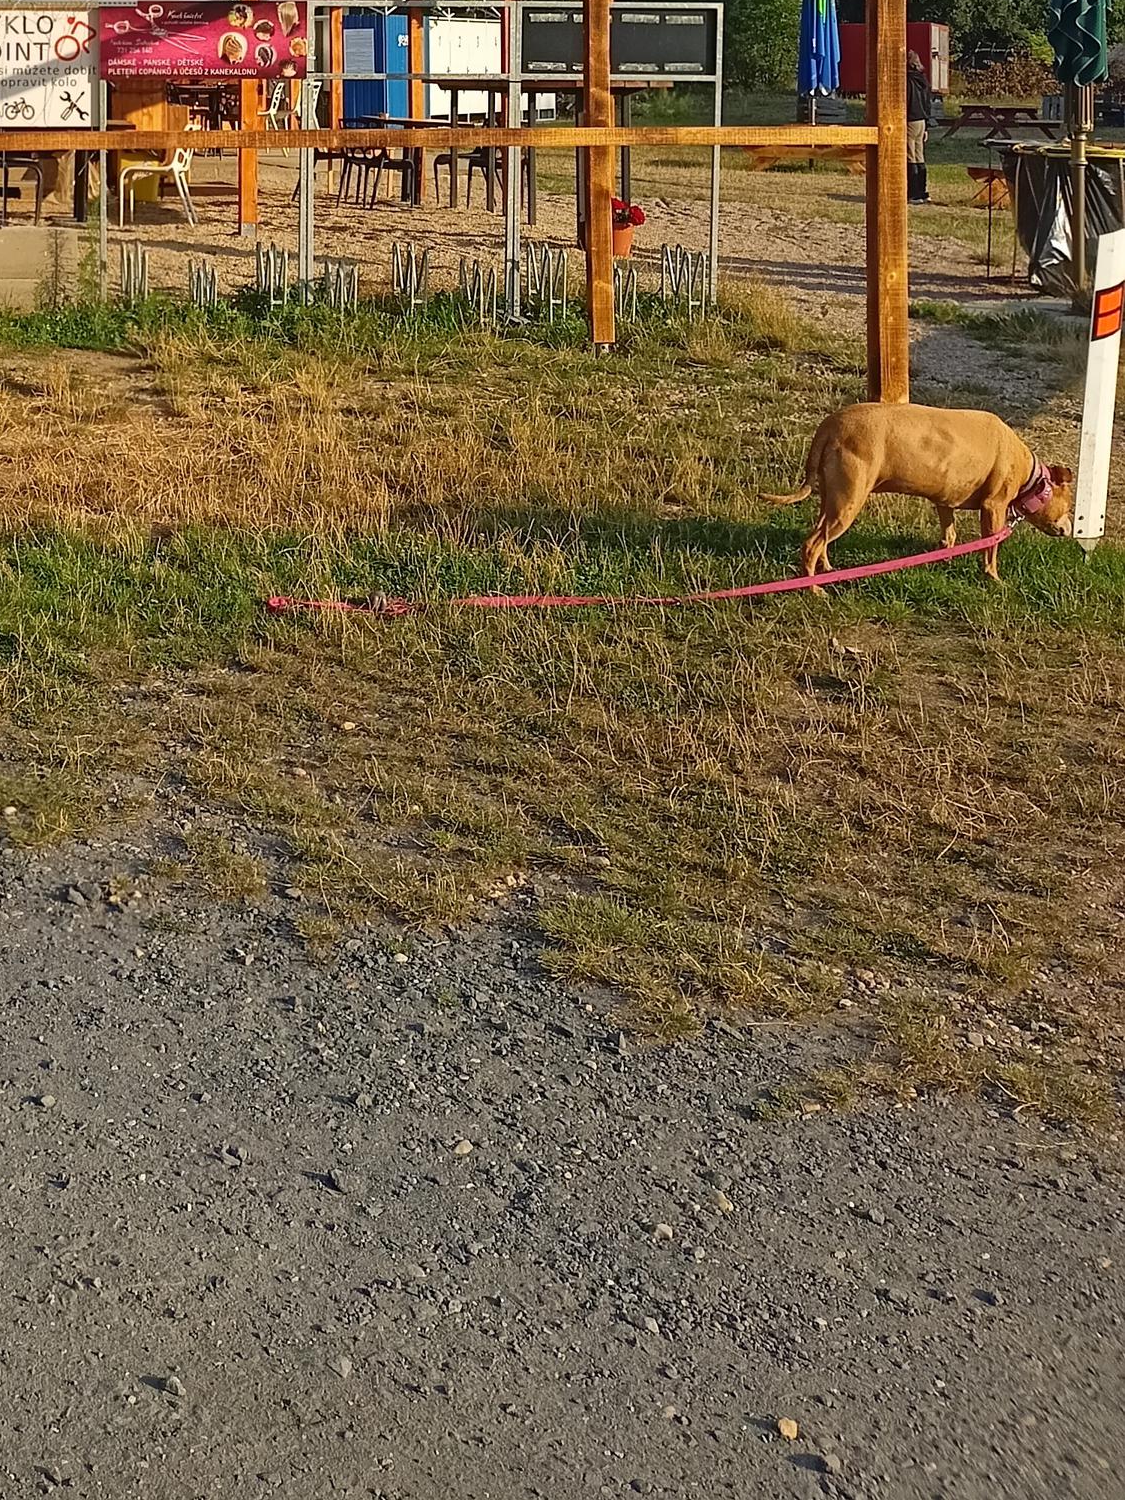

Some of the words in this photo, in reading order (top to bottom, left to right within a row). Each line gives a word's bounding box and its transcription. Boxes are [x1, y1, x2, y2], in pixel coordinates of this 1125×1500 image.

[108, 58, 137, 66] DÁMSKÉ
[143, 58, 171, 66] PÁNSKÉ
[177, 58, 204, 66] DĚTSKÉ
[12, 65, 60, 75] můžete
[64, 65, 97, 75] dobít
[108, 67, 137, 75] PLETENÍ
[210, 68, 257, 76] KANEKALONU
[0, 78, 47, 90] opravit
[52, 78, 77, 87] kolo
